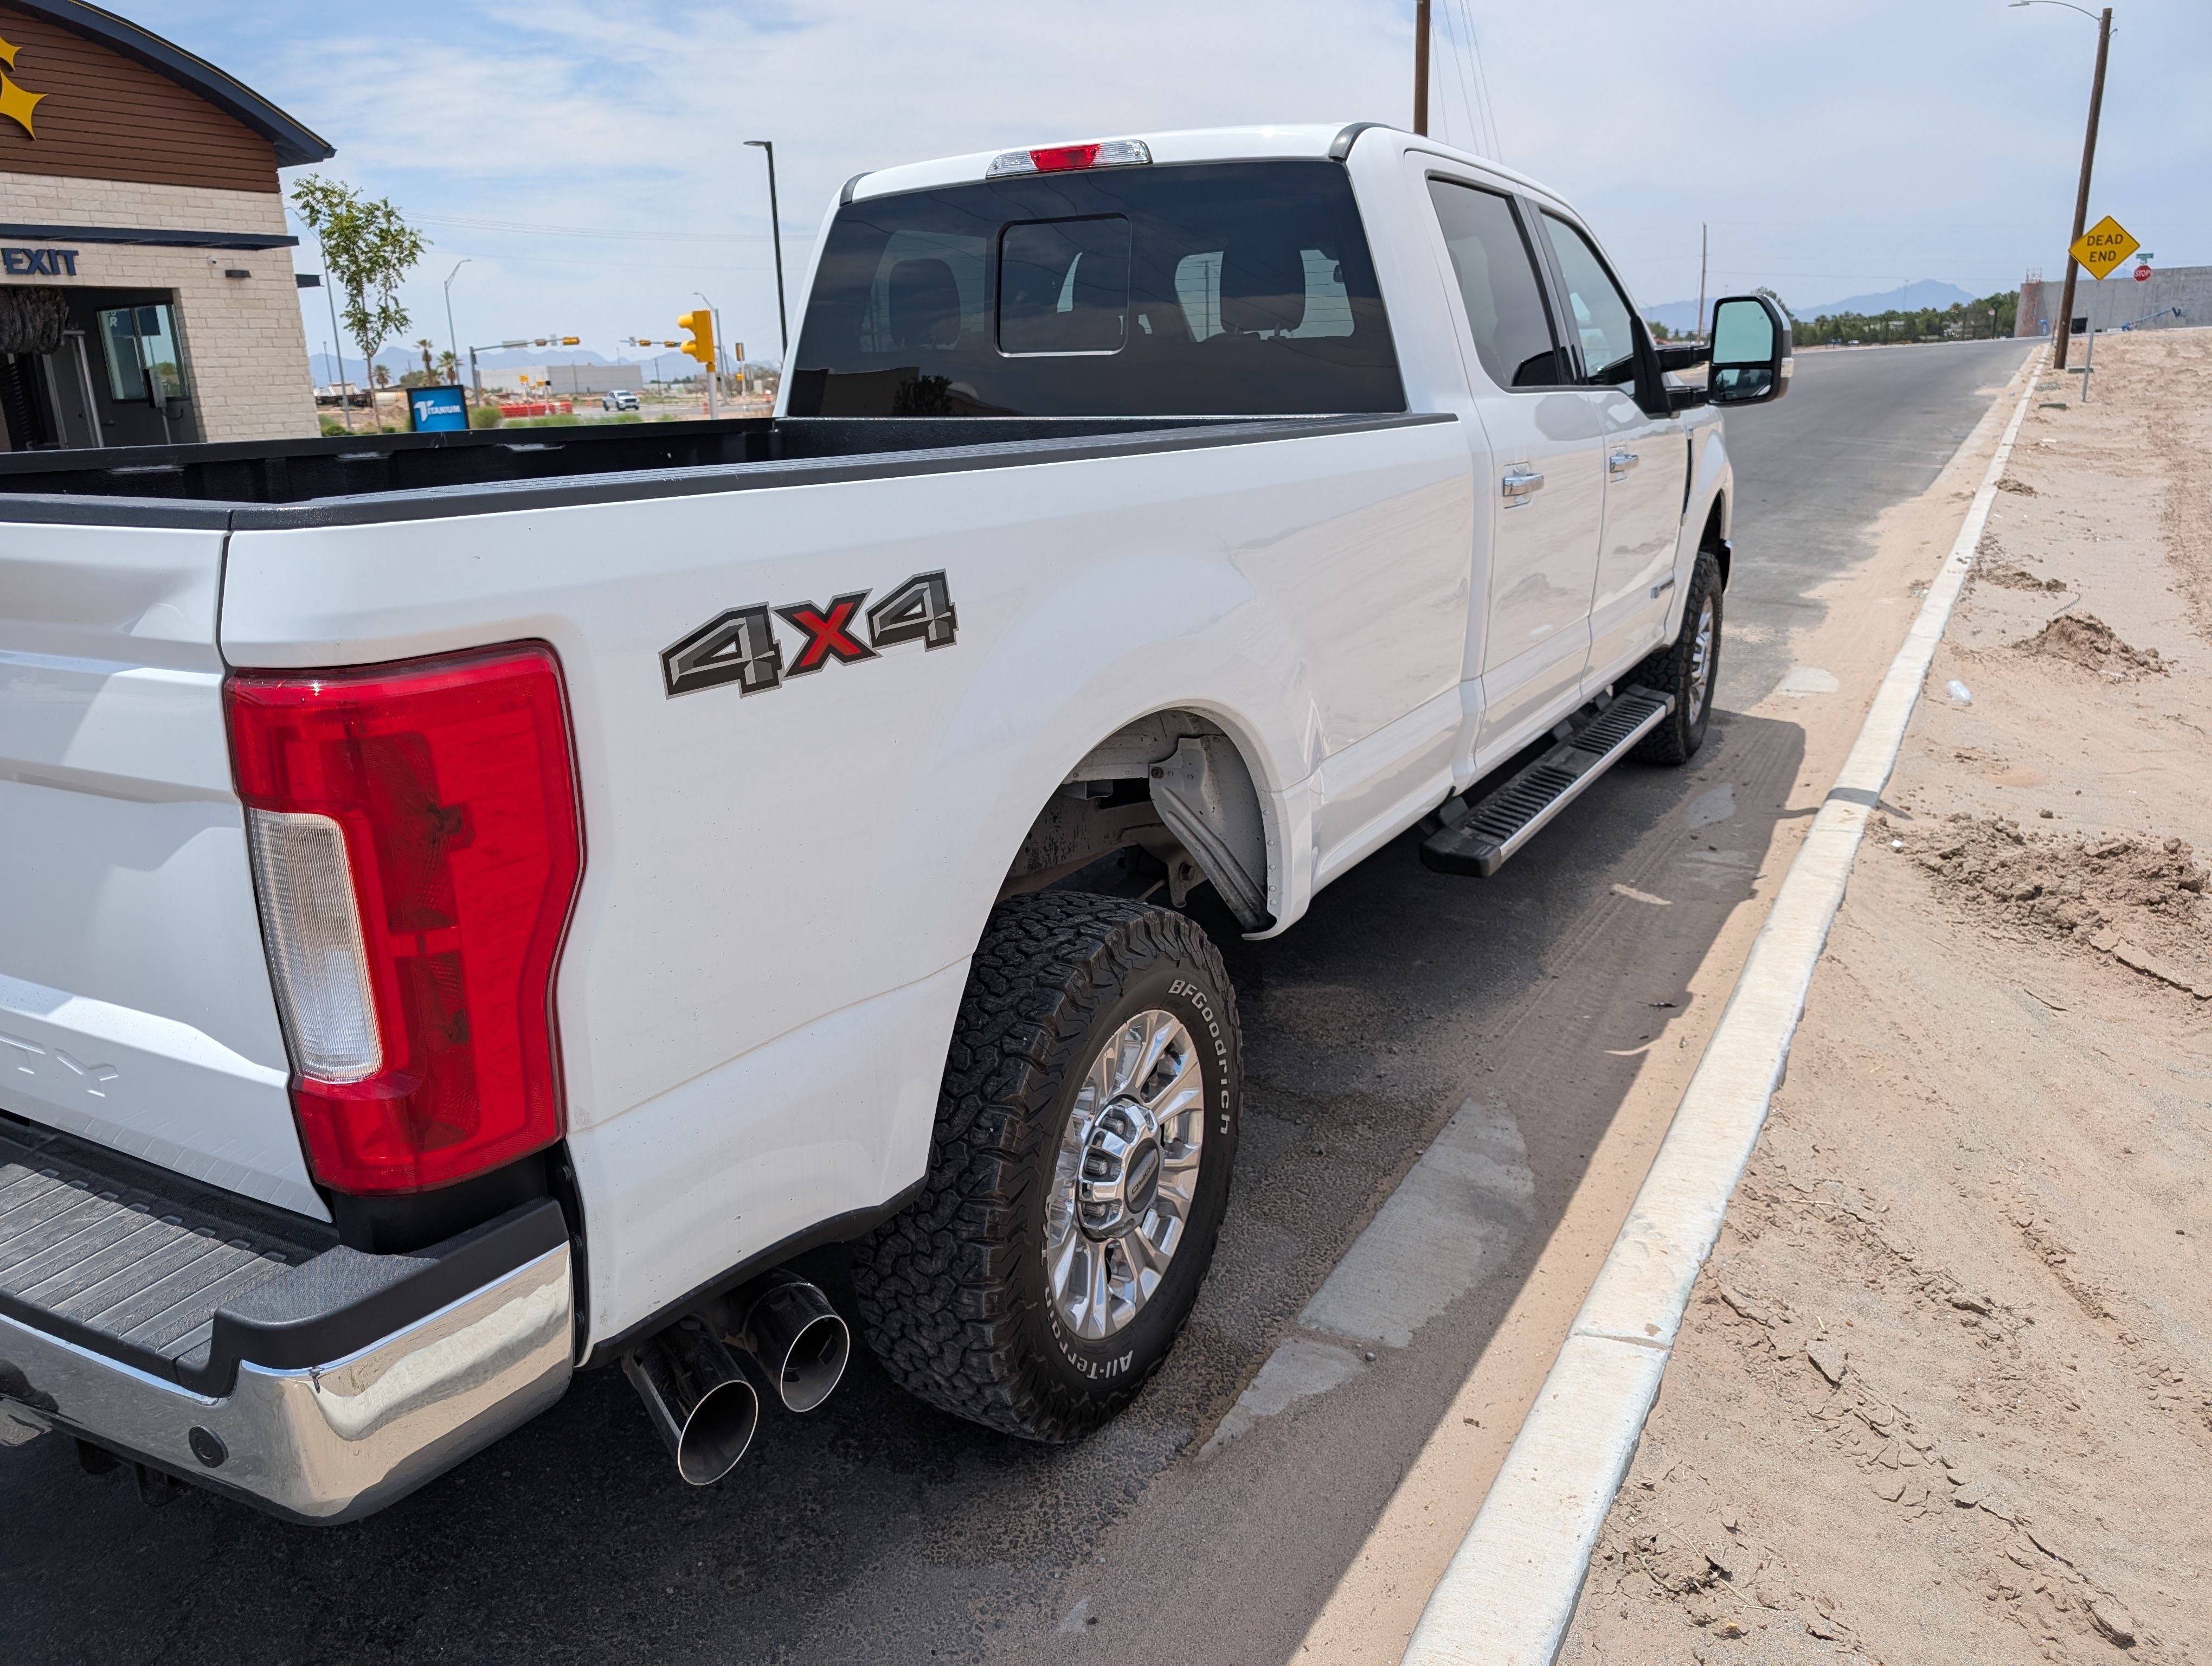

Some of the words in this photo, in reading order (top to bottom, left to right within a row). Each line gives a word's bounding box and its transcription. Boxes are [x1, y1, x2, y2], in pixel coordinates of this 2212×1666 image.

[2087, 234, 2123, 246] DEAD
[1, 248, 79, 275] EXIT
[2089, 250, 2117, 262] END
[1168, 979, 1230, 1135] BFGoodrich
[1131, 1157, 1156, 1194] FORD
